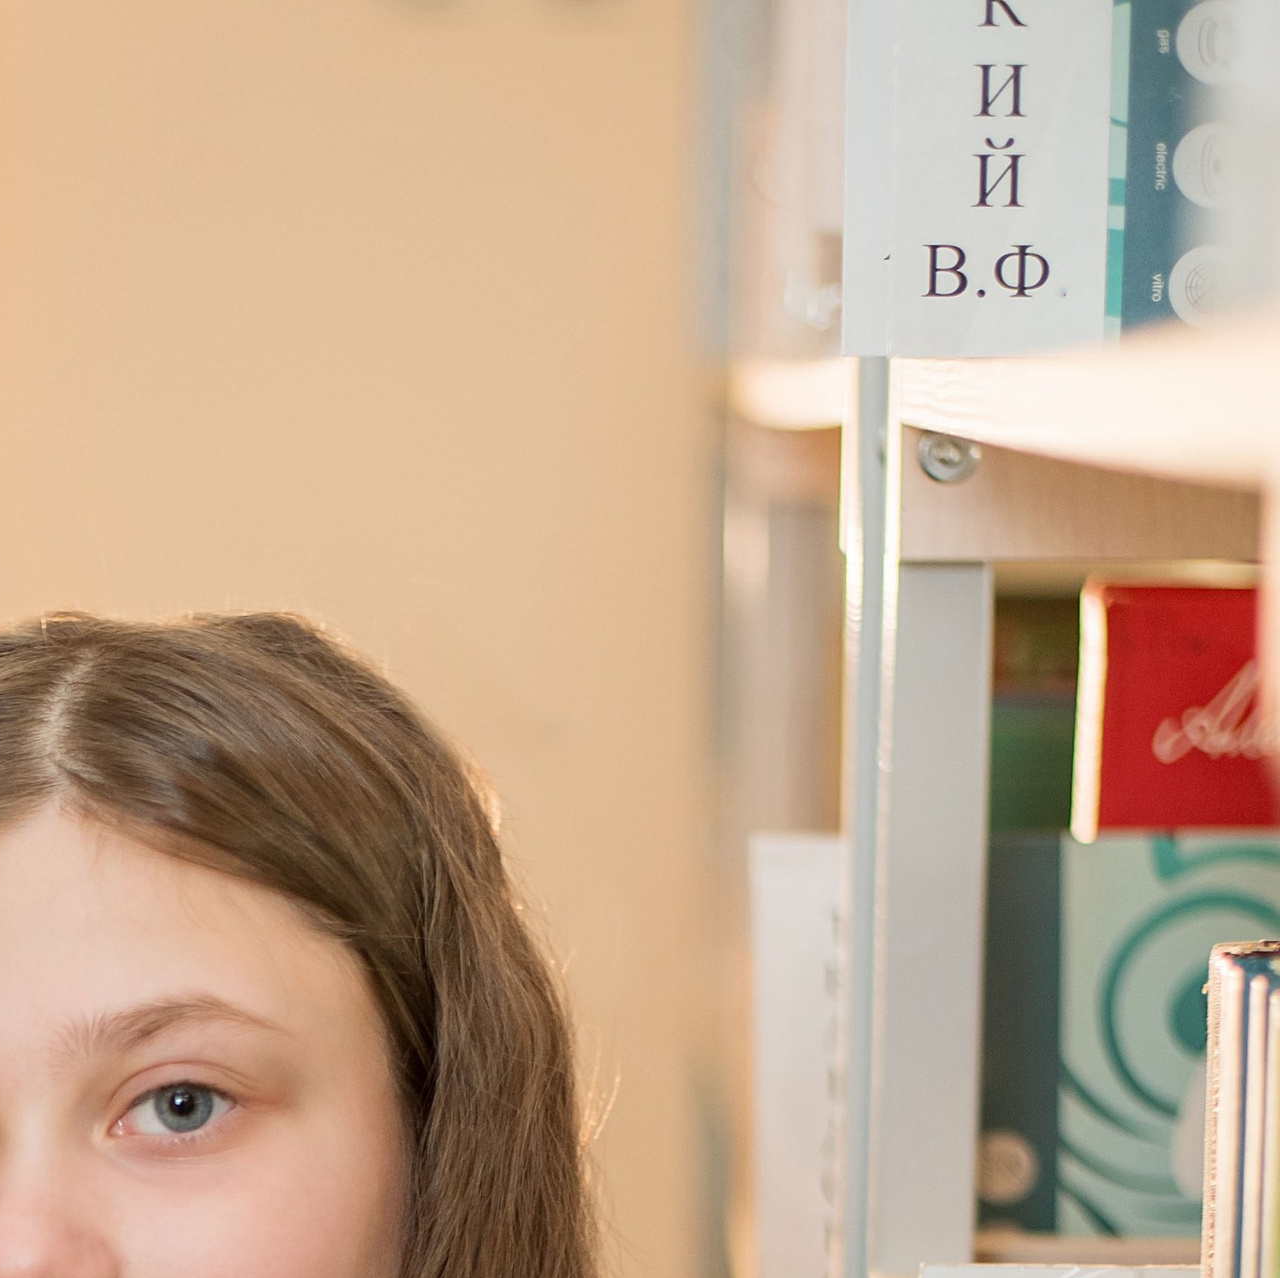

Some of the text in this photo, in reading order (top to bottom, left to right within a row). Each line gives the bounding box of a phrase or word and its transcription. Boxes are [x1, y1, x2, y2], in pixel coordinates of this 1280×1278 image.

[1156, 29, 1170, 54] gas
[1155, 142, 1167, 191] electric
[1151, 273, 1162, 302] vitro
